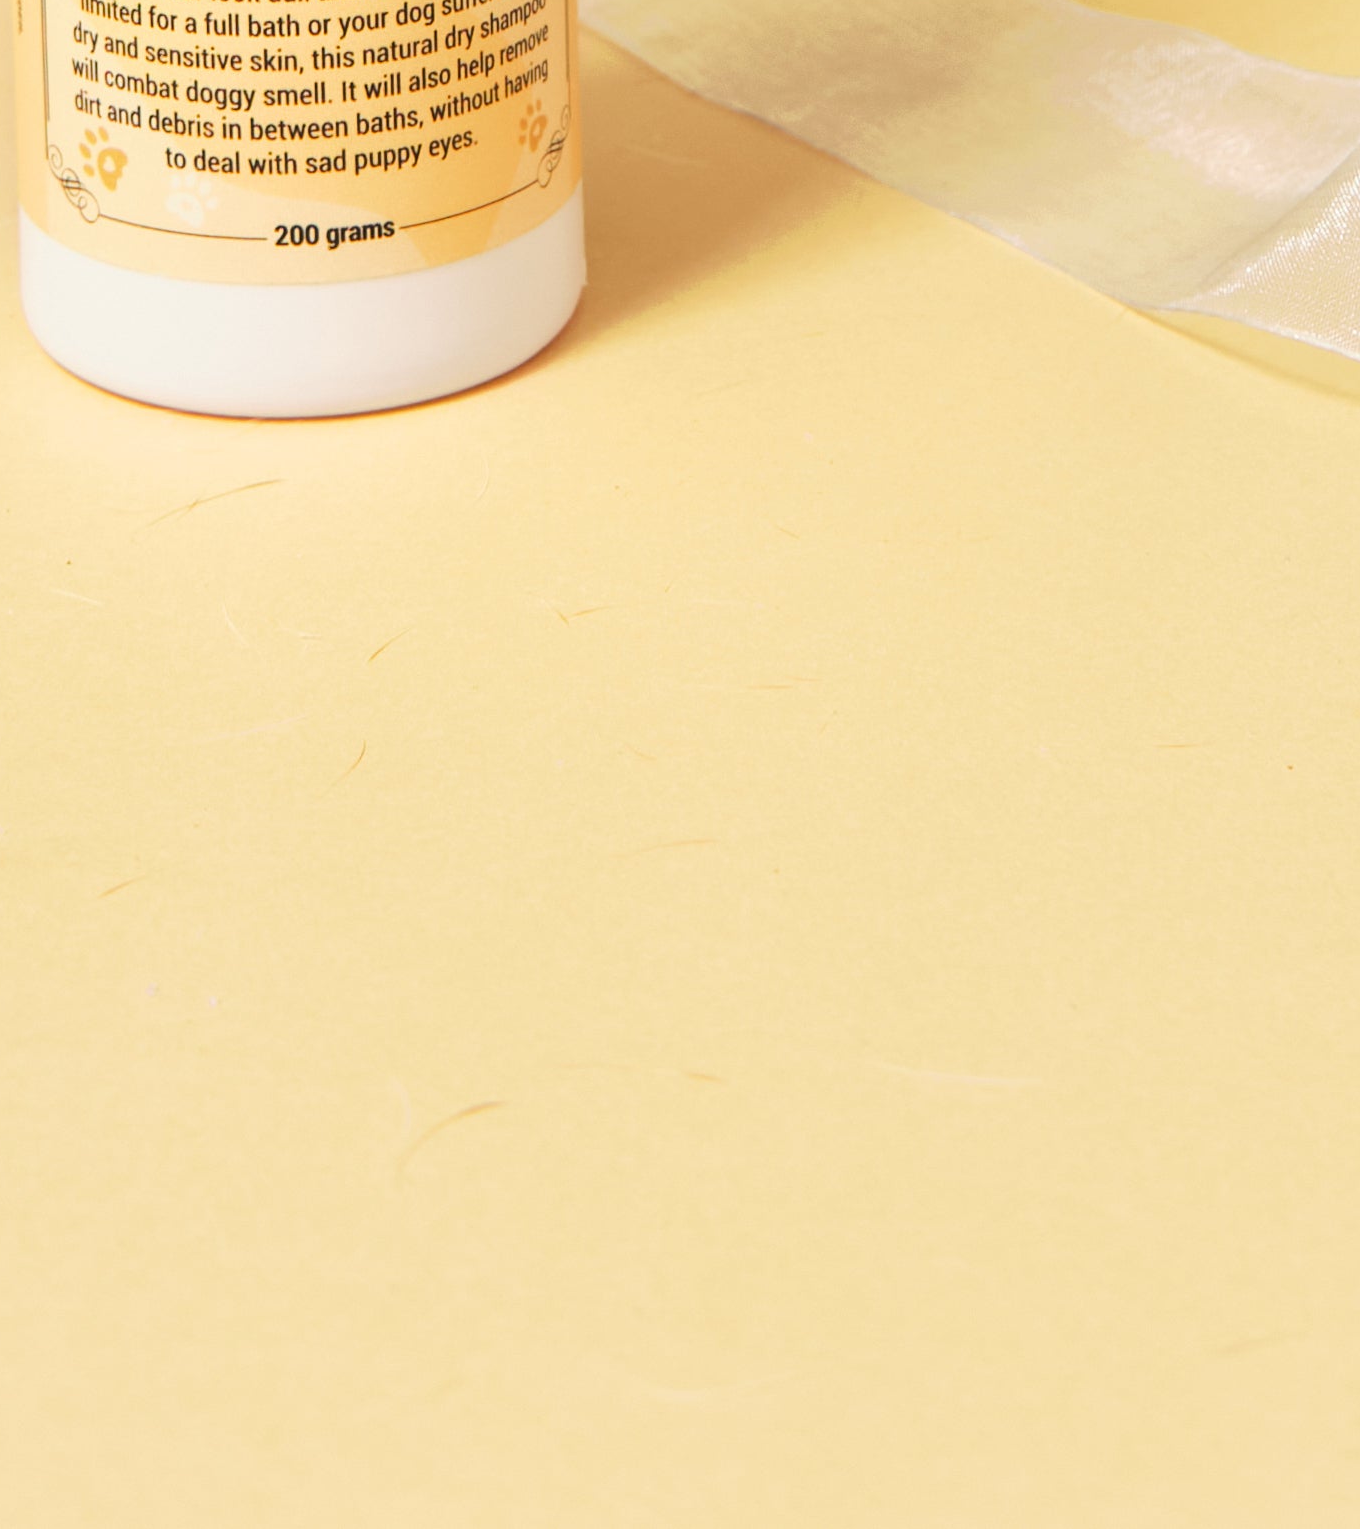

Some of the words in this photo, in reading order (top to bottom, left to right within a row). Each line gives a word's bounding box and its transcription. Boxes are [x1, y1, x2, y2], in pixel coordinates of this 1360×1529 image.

[148, 5, 178, 33] for
[184, 15, 197, 34] a
[203, 11, 241, 37] full
[247, 12, 300, 38] bath
[307, 15, 333, 38] or
[339, 11, 389, 41] your
[396, 1, 435, 29] dog
[72, 57, 100, 82] will
[105, 69, 179, 100] combat
[186, 80, 256, 110] doggy
[263, 81, 334, 106] smell.
[341, 79, 358, 102] It
[365, 73, 402, 99] will
[409, 66, 452, 92] also
[457, 52, 495, 84] help
[500, 23, 549, 65] remove
[73, 21, 99, 54] dry
[104, 33, 138, 59] and
[145, 43, 243, 71] sensitive
[249, 45, 305, 75] skin,
[311, 44, 356, 72] this
[362, 31, 439, 66] natural
[445, 24, 475, 56] dry
[74, 91, 102, 118] dirt
[107, 101, 142, 128] and
[148, 110, 216, 139] debris
[222, 116, 243, 140] in
[249, 112, 350, 142] between
[357, 108, 423, 137] baths,
[430, 84, 500, 122] without
[504, 58, 549, 98] having
[165, 147, 187, 169] to
[193, 149, 241, 174] deal
[247, 149, 299, 175] with
[305, 148, 347, 173] sad
[354, 144, 422, 175] puppy
[429, 129, 479, 159] eyes.
[274, 222, 320, 248] 200
[327, 219, 395, 248] grams
